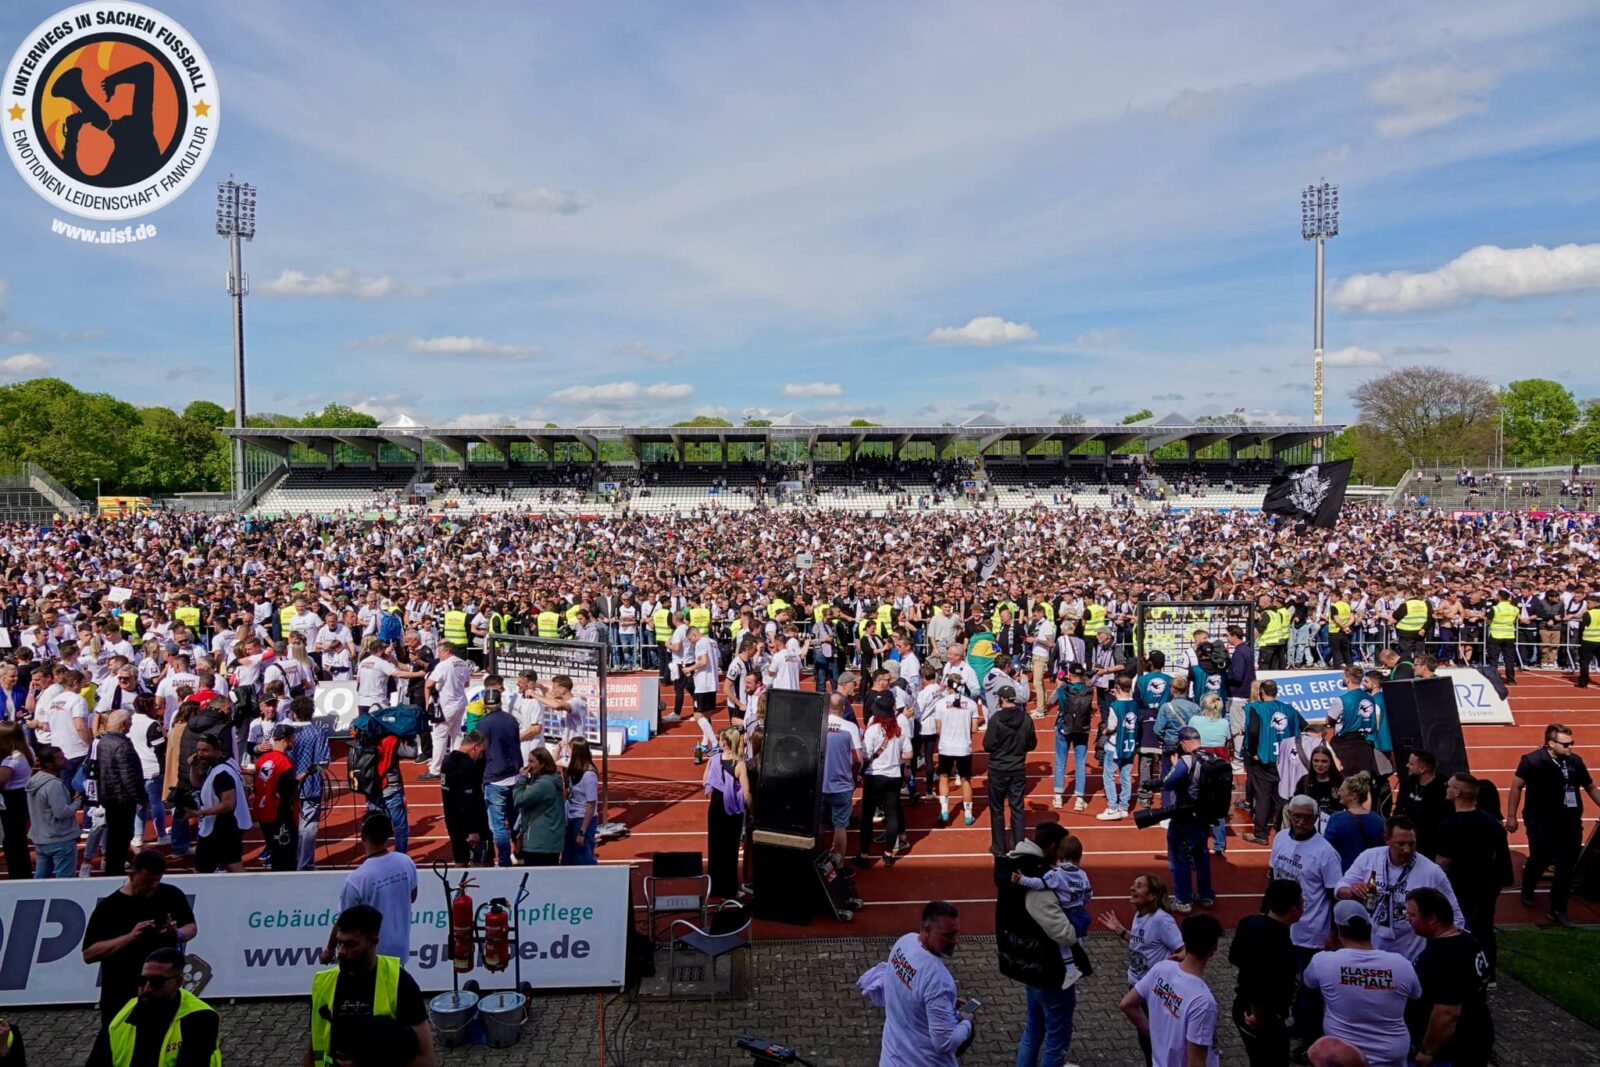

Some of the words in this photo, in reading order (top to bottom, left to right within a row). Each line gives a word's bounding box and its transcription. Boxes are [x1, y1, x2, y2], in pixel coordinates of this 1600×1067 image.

[1123, 739, 1136, 752] 17
[1340, 966, 1393, 979] KLASSEN
[1340, 975, 1393, 988] ERHALT
